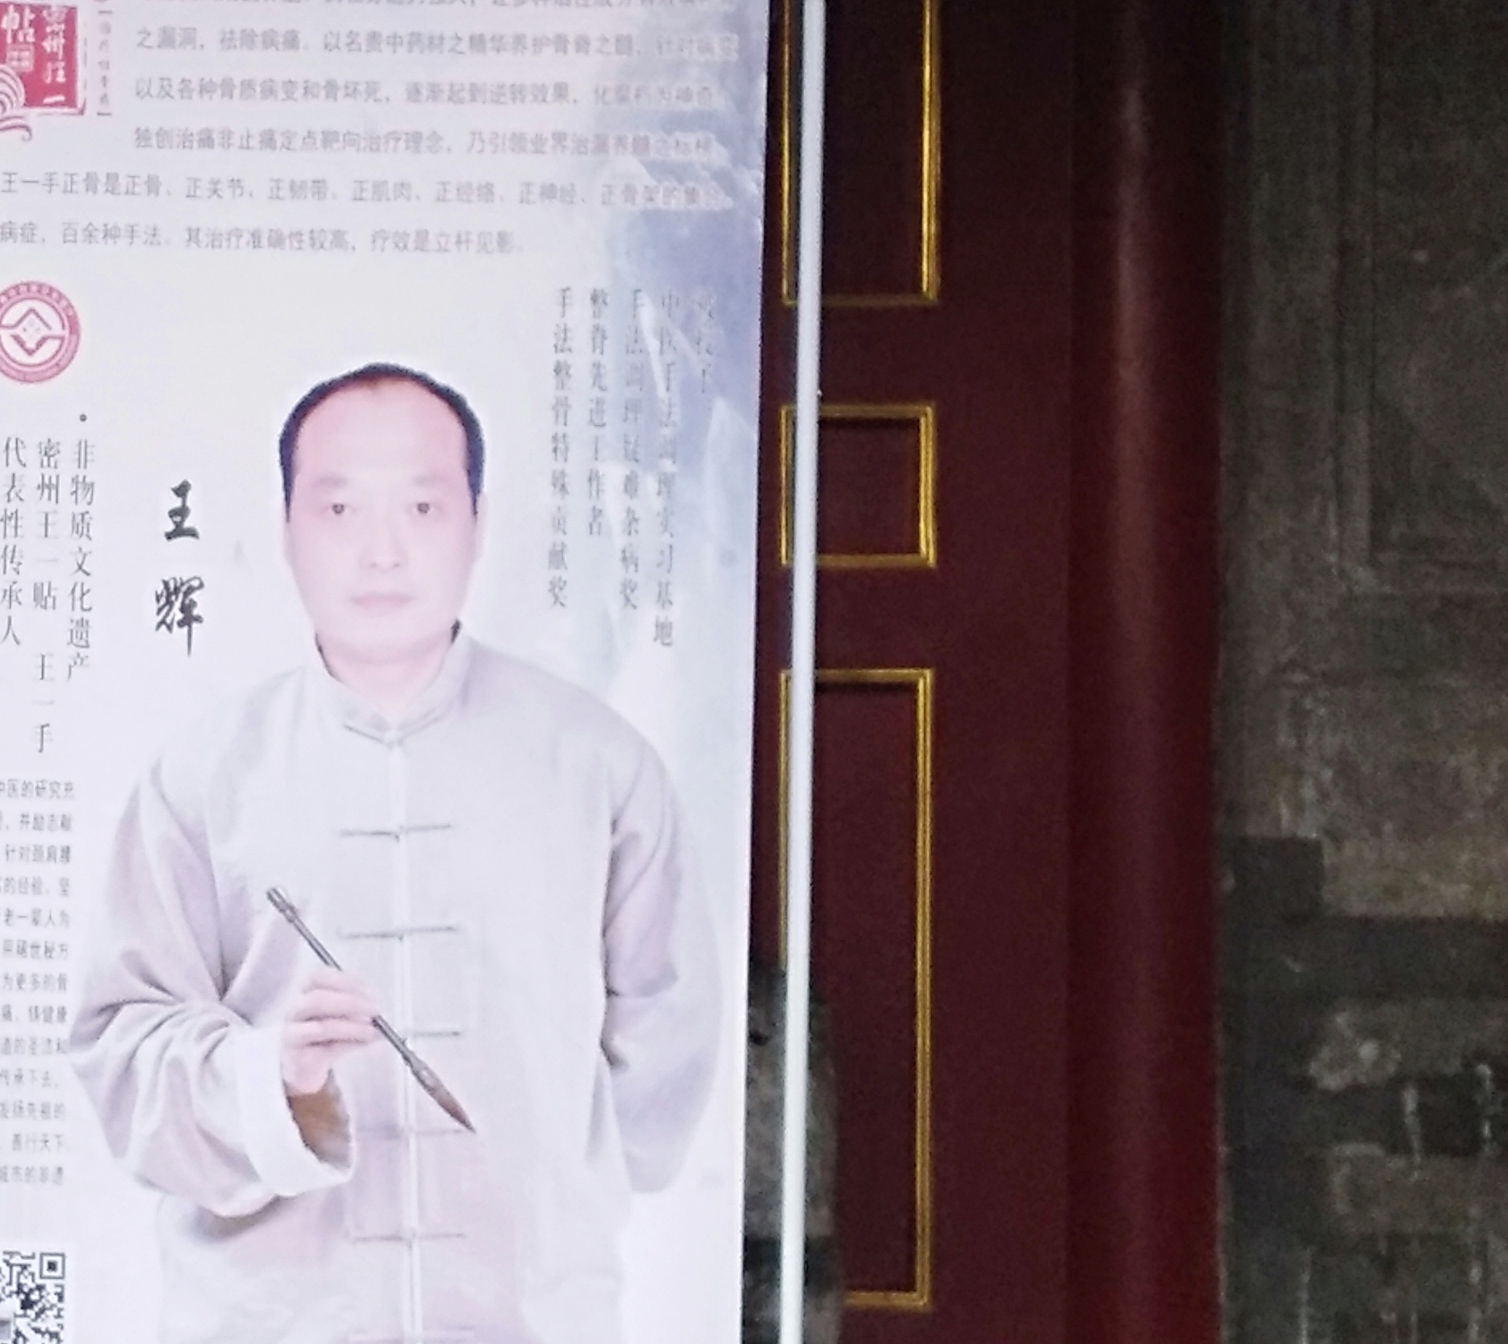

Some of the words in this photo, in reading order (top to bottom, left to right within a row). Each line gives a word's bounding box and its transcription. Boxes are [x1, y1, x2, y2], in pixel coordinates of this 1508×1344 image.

[0, 435, 27, 647] 代表性传承人
[32, 437, 62, 611] 密州王一贴
[66, 438, 95, 683] 非物质文化遗产
[31, 652, 57, 755] 王一手
